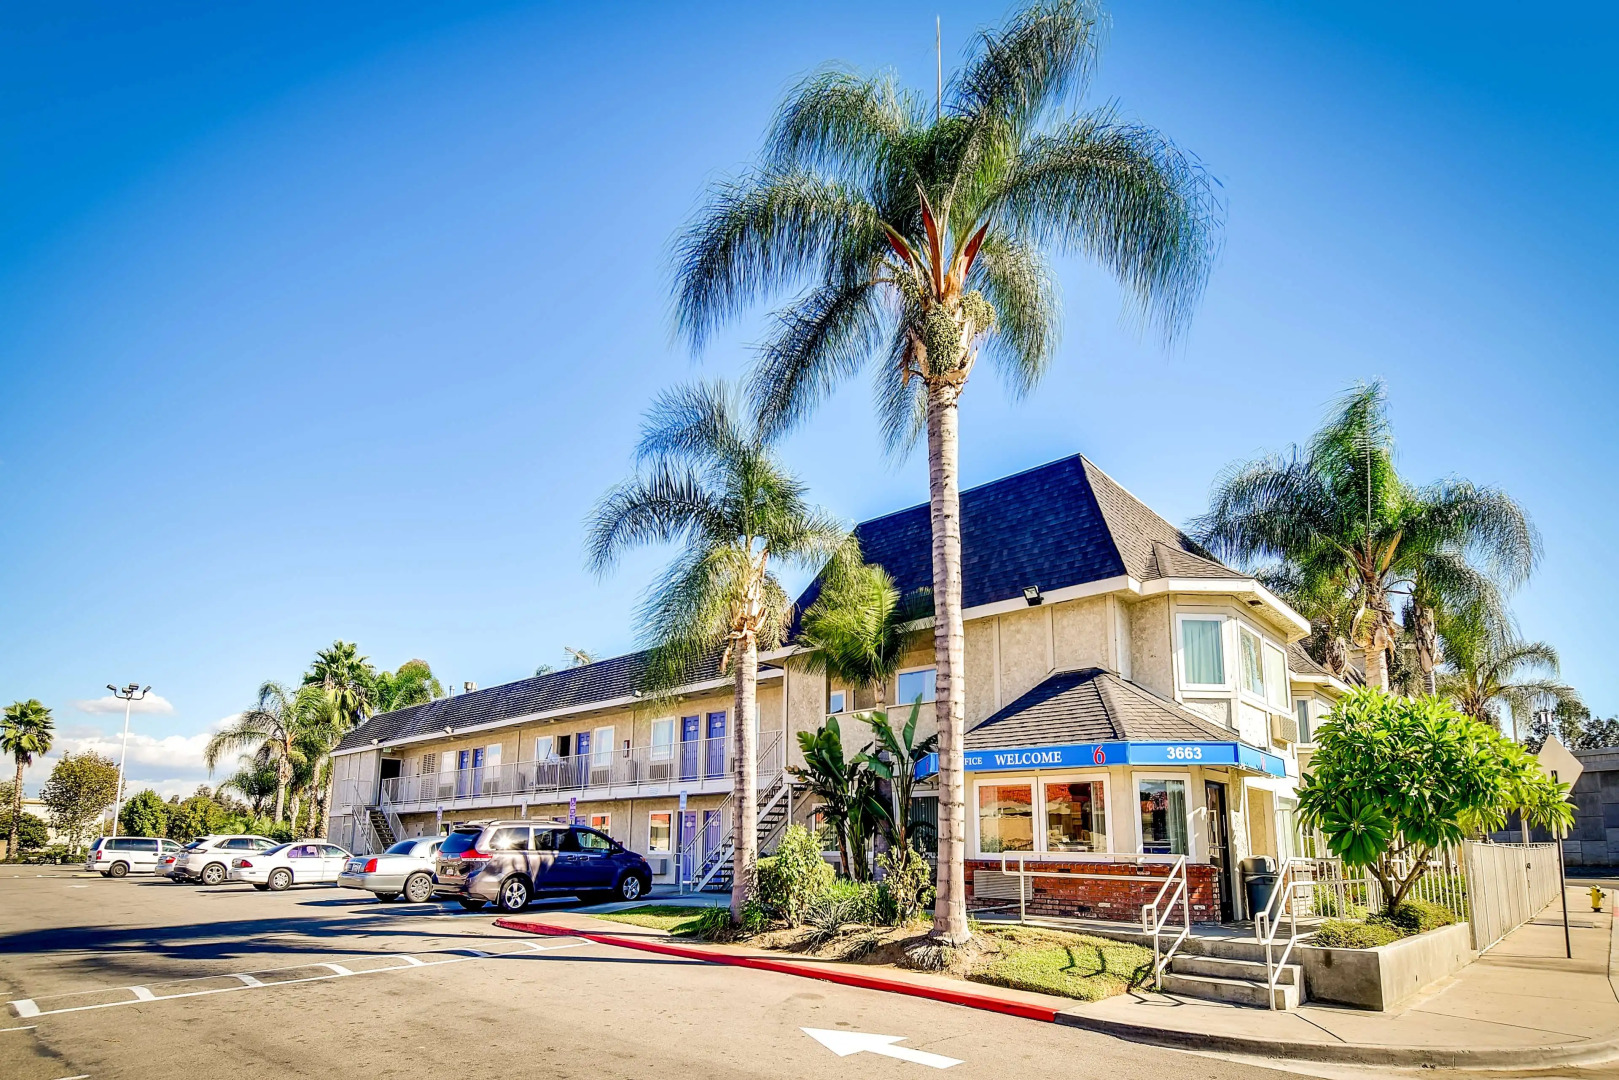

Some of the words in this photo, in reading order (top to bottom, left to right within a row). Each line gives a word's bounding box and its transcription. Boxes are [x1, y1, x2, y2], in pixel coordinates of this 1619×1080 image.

[964, 757, 983, 766] FICE
[994, 751, 1062, 766] WELCOME
[1093, 745, 1106, 765] 6
[1166, 747, 1202, 760] 3663
